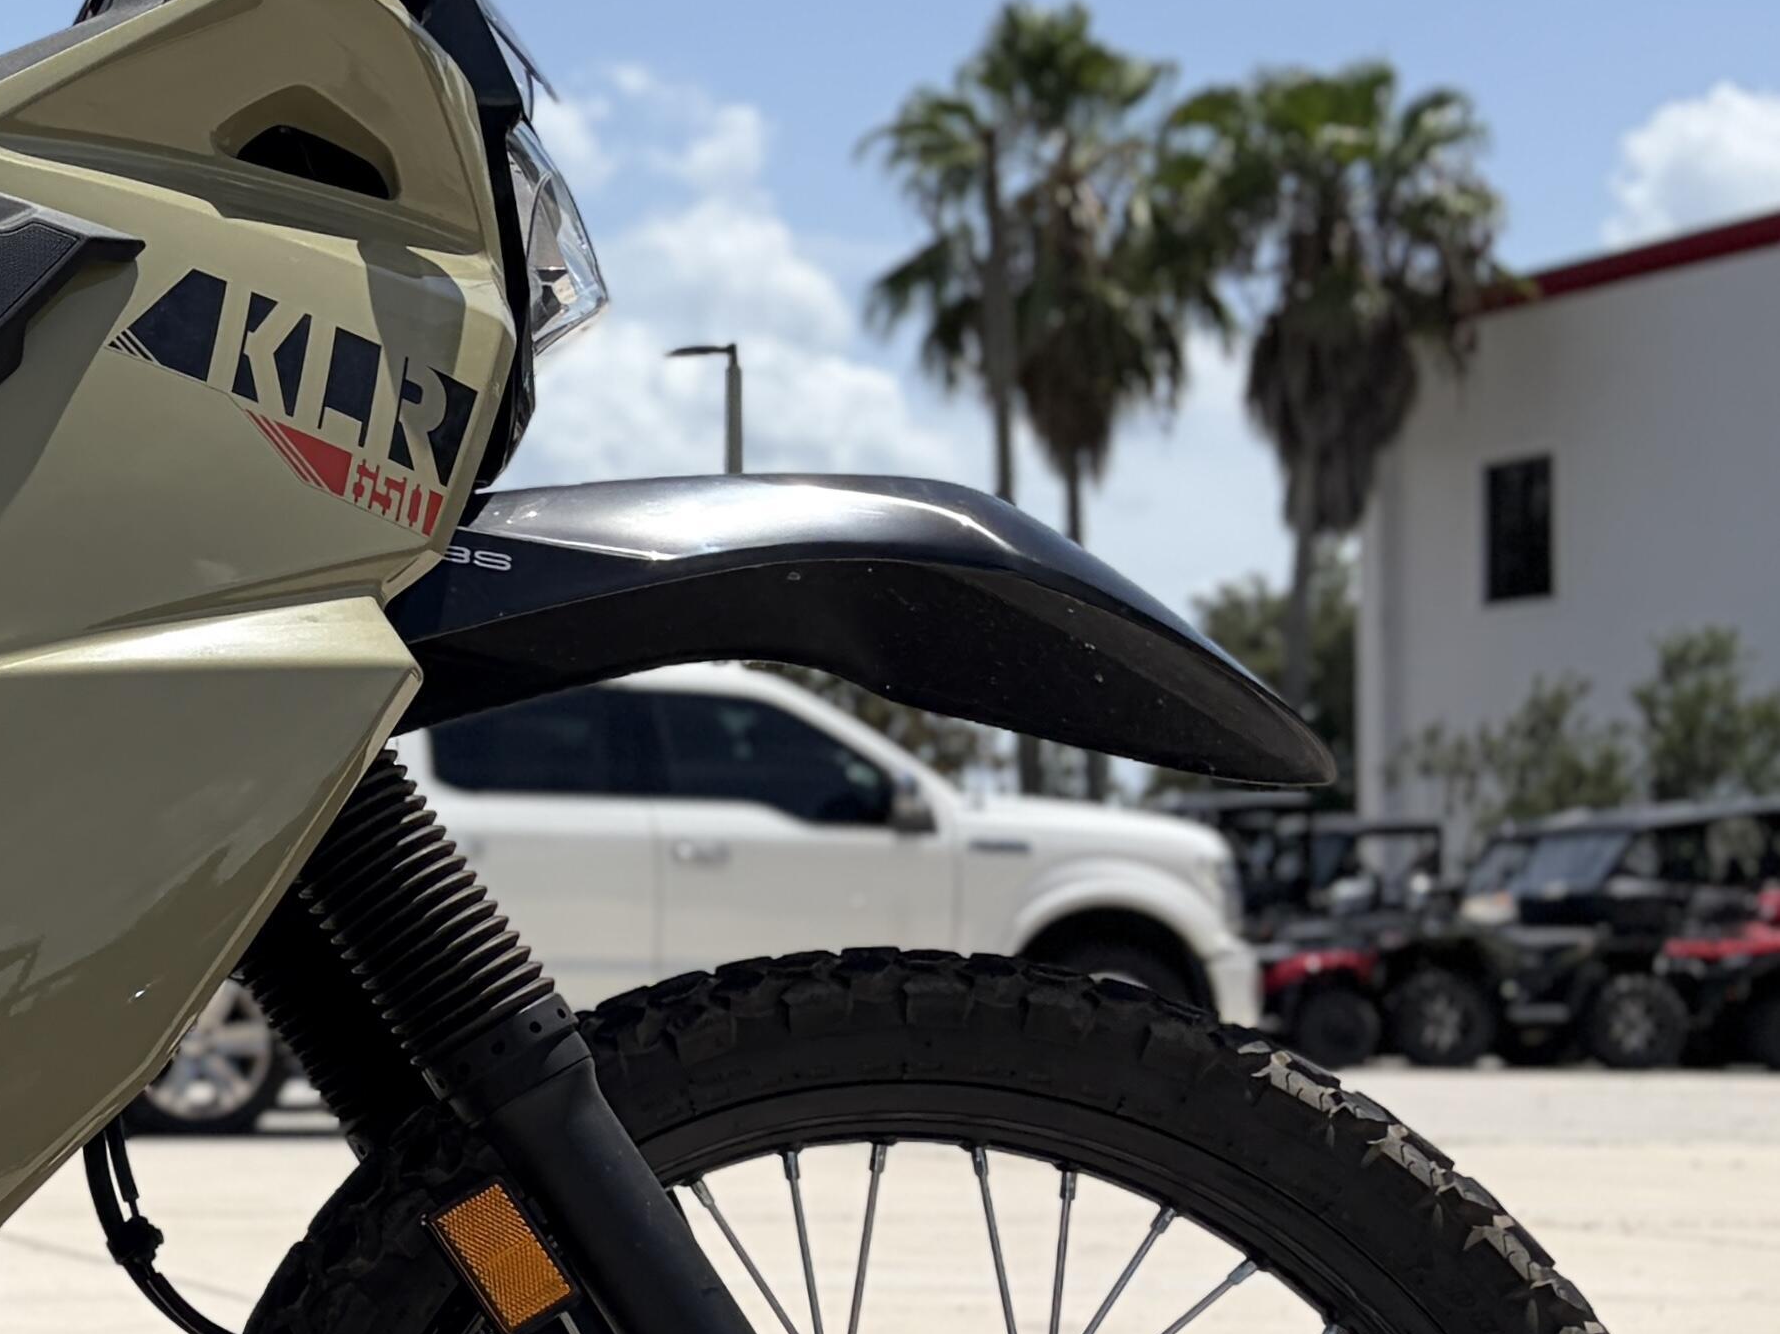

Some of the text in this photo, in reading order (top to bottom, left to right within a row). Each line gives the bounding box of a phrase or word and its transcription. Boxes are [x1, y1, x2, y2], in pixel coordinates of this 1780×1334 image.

[207, 279, 447, 488] KLR
[343, 453, 433, 535] 650
[444, 545, 513, 571] BS
